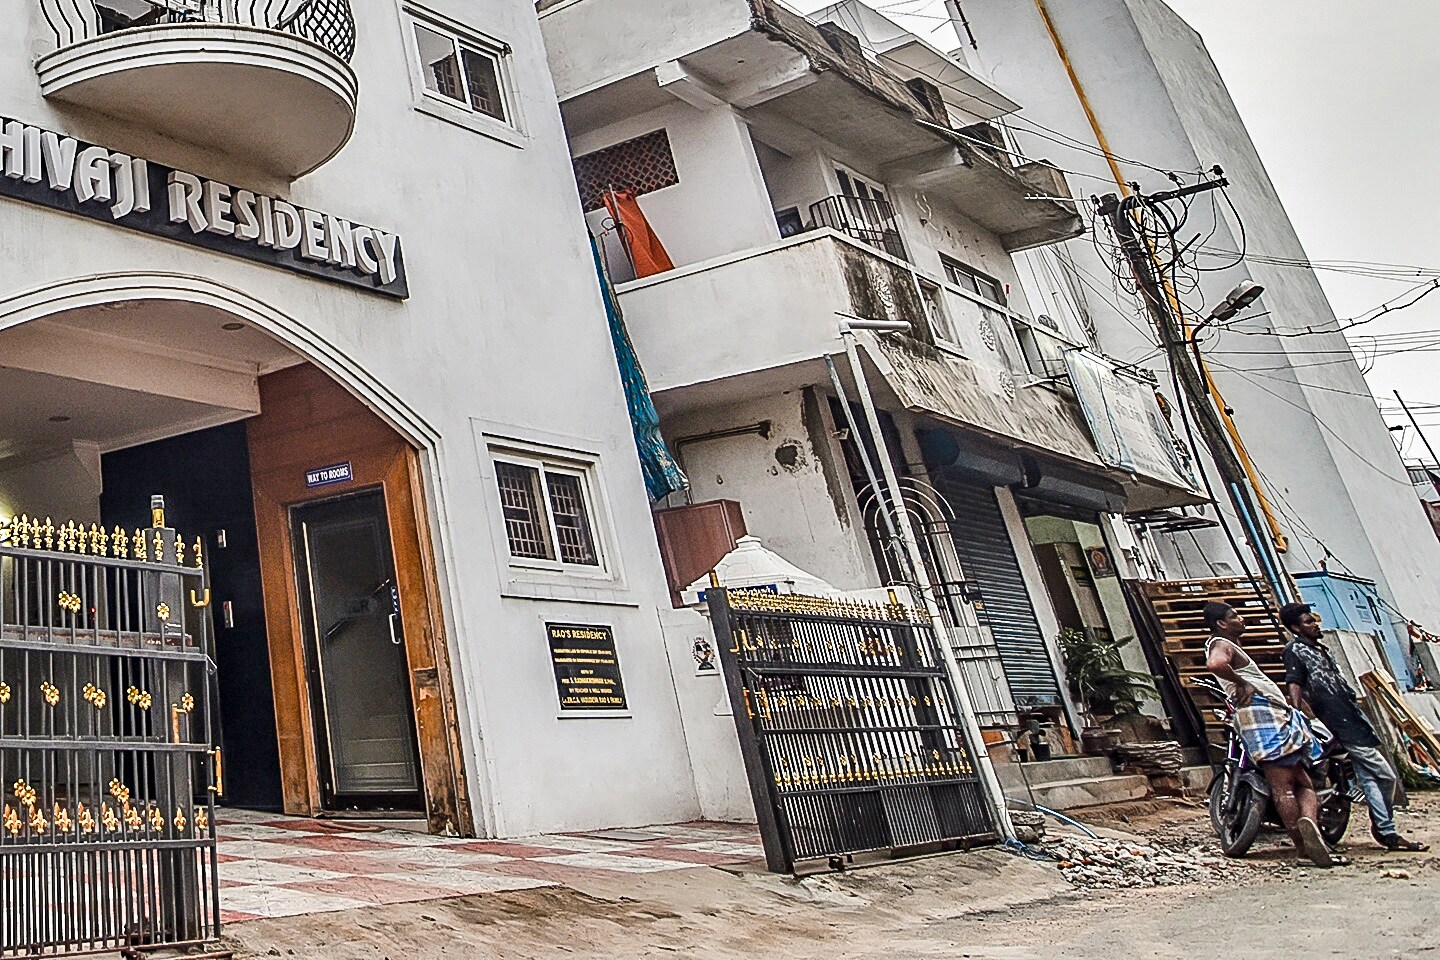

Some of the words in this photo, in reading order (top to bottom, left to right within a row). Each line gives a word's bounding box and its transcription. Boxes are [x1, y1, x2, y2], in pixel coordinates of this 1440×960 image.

[167, 169, 400, 286] RESIDENCY
[307, 474, 320, 483] WAY
[320, 471, 328, 481] TO
[328, 467, 349, 479] ROOMS
[572, 630, 607, 640] RESIDENCY
